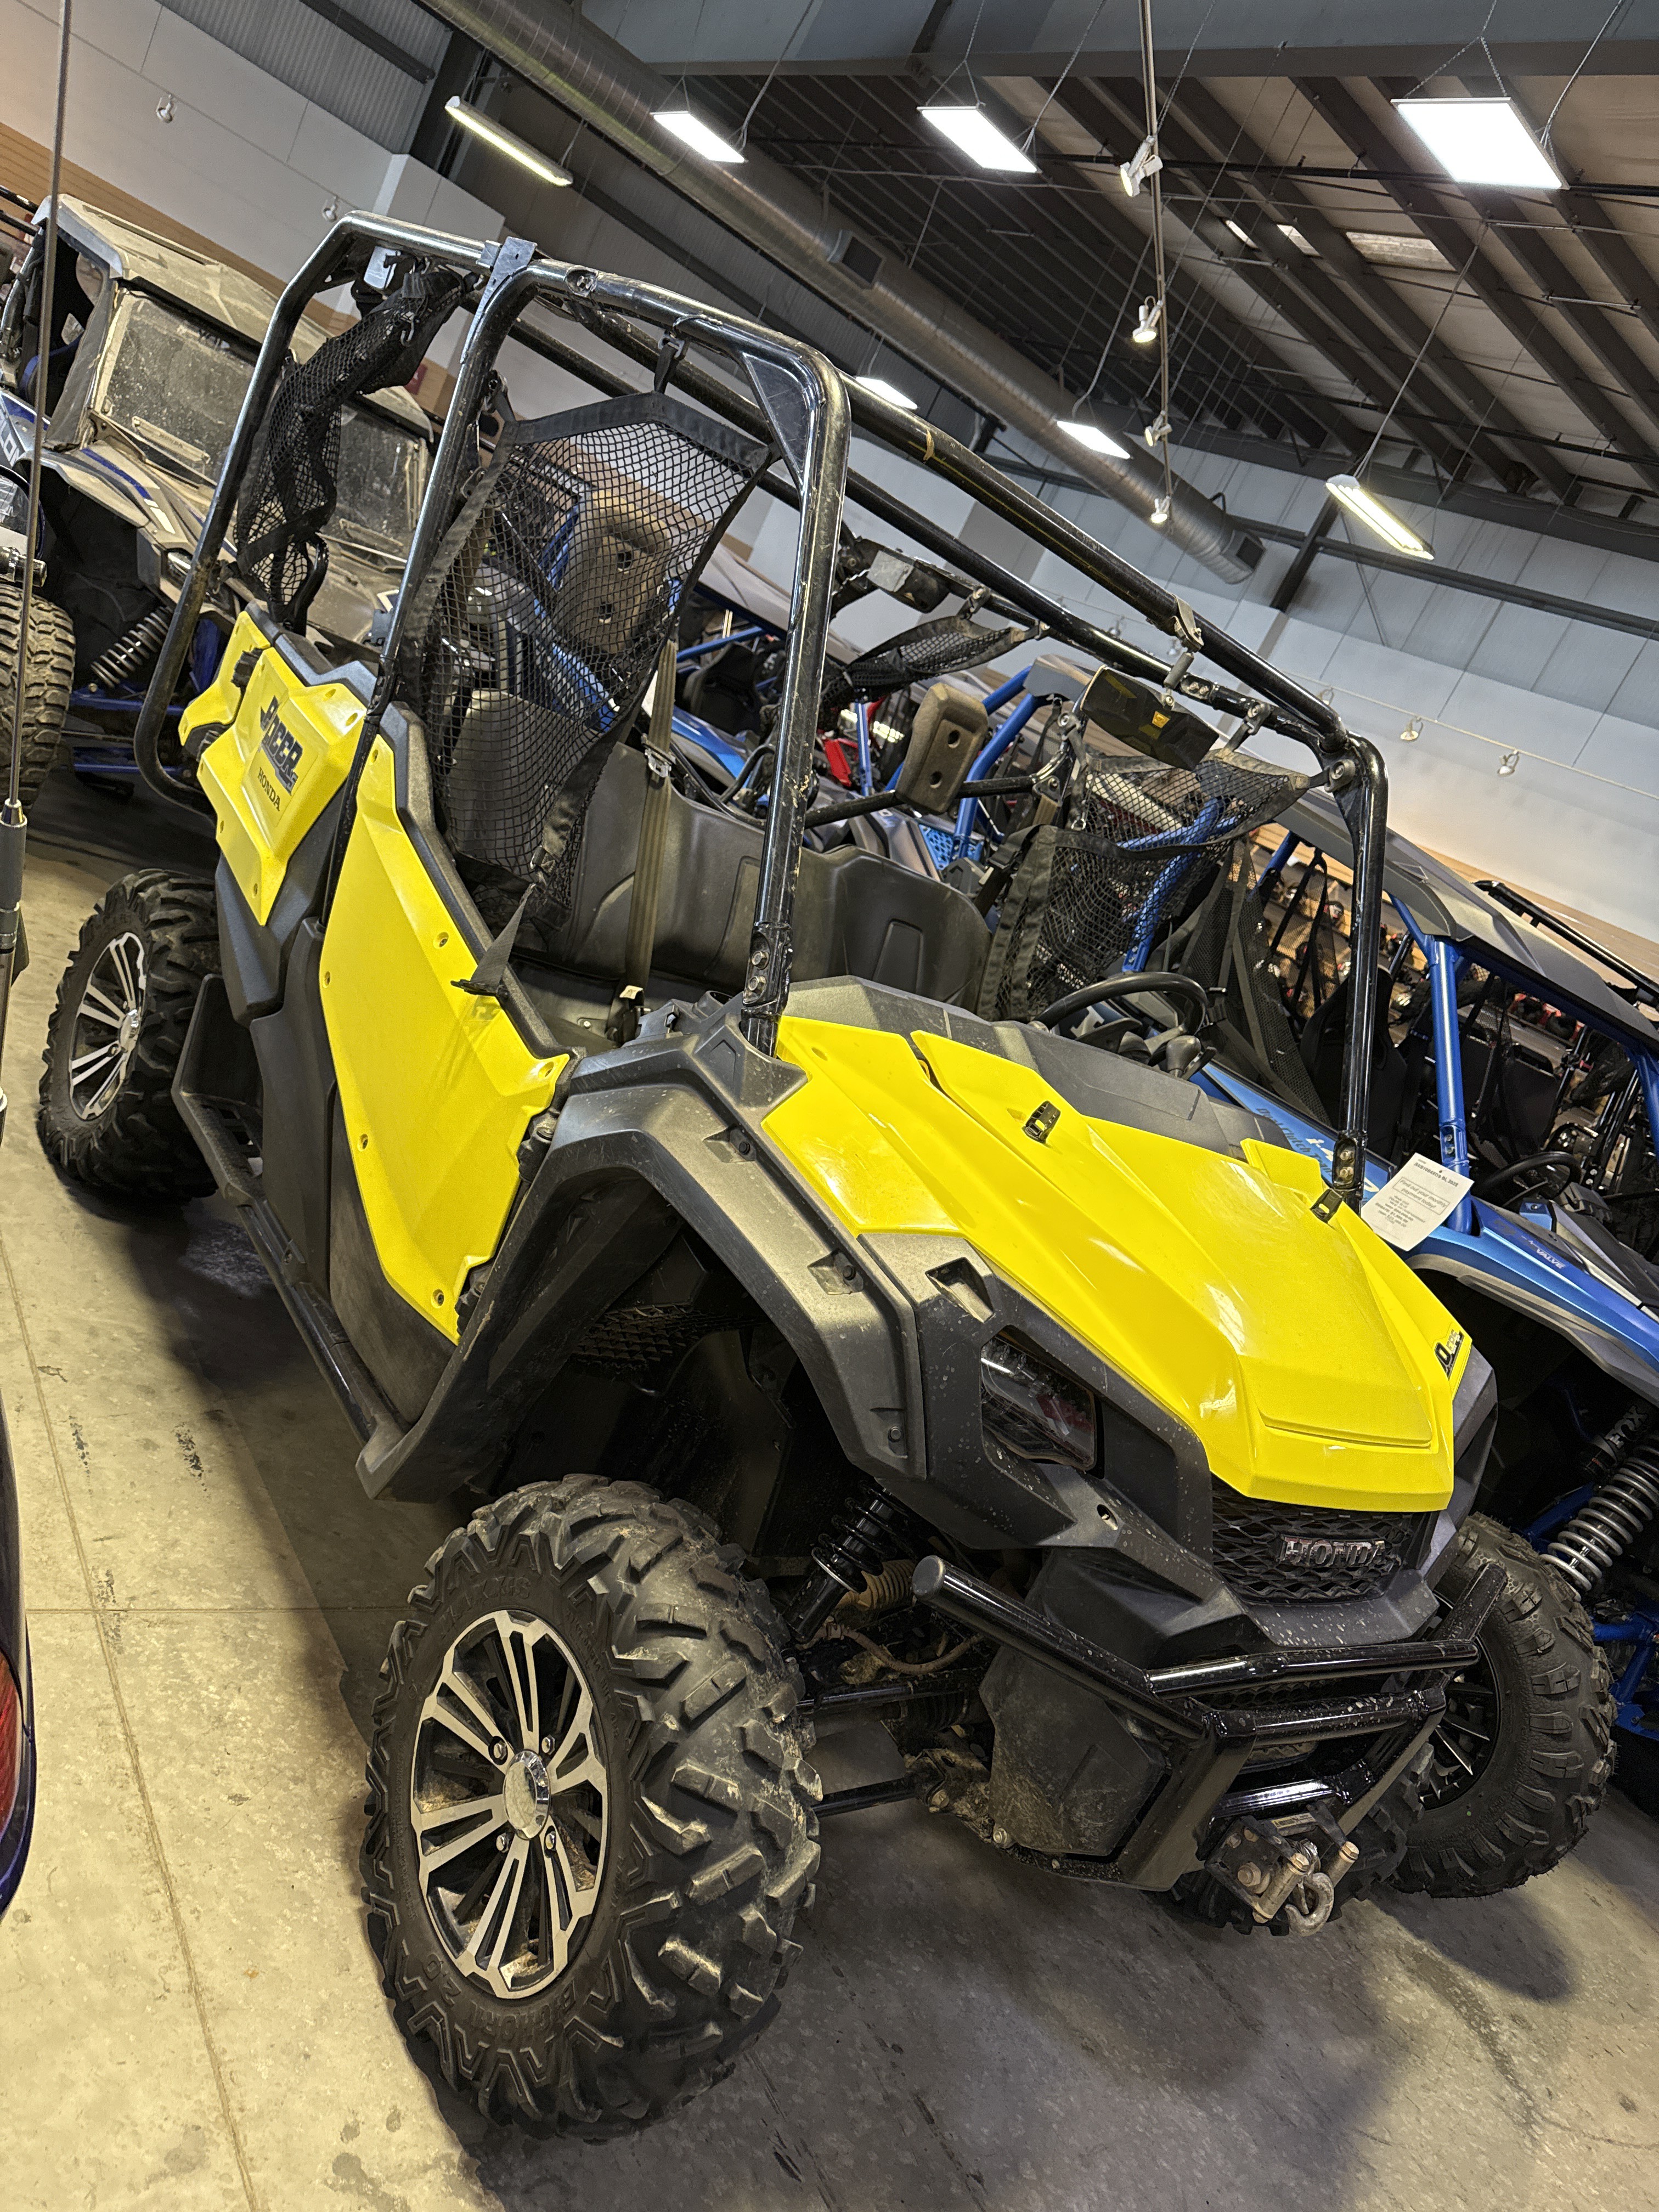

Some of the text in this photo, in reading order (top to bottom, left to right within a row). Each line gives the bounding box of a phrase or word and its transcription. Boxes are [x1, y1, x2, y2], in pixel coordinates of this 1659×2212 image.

[257, 767, 280, 812] HONDA
[1399, 1179, 1411, 1187] Find
[1428, 1195, 1447, 1208] monthly
[1400, 1188, 1436, 1209] payment today!
[1536, 1248, 1566, 1269] VALVE
[1604, 1406, 1647, 1449] FOX
[1279, 1536, 1386, 1567] HONDA
[423, 1951, 462, 2006] 2.0
